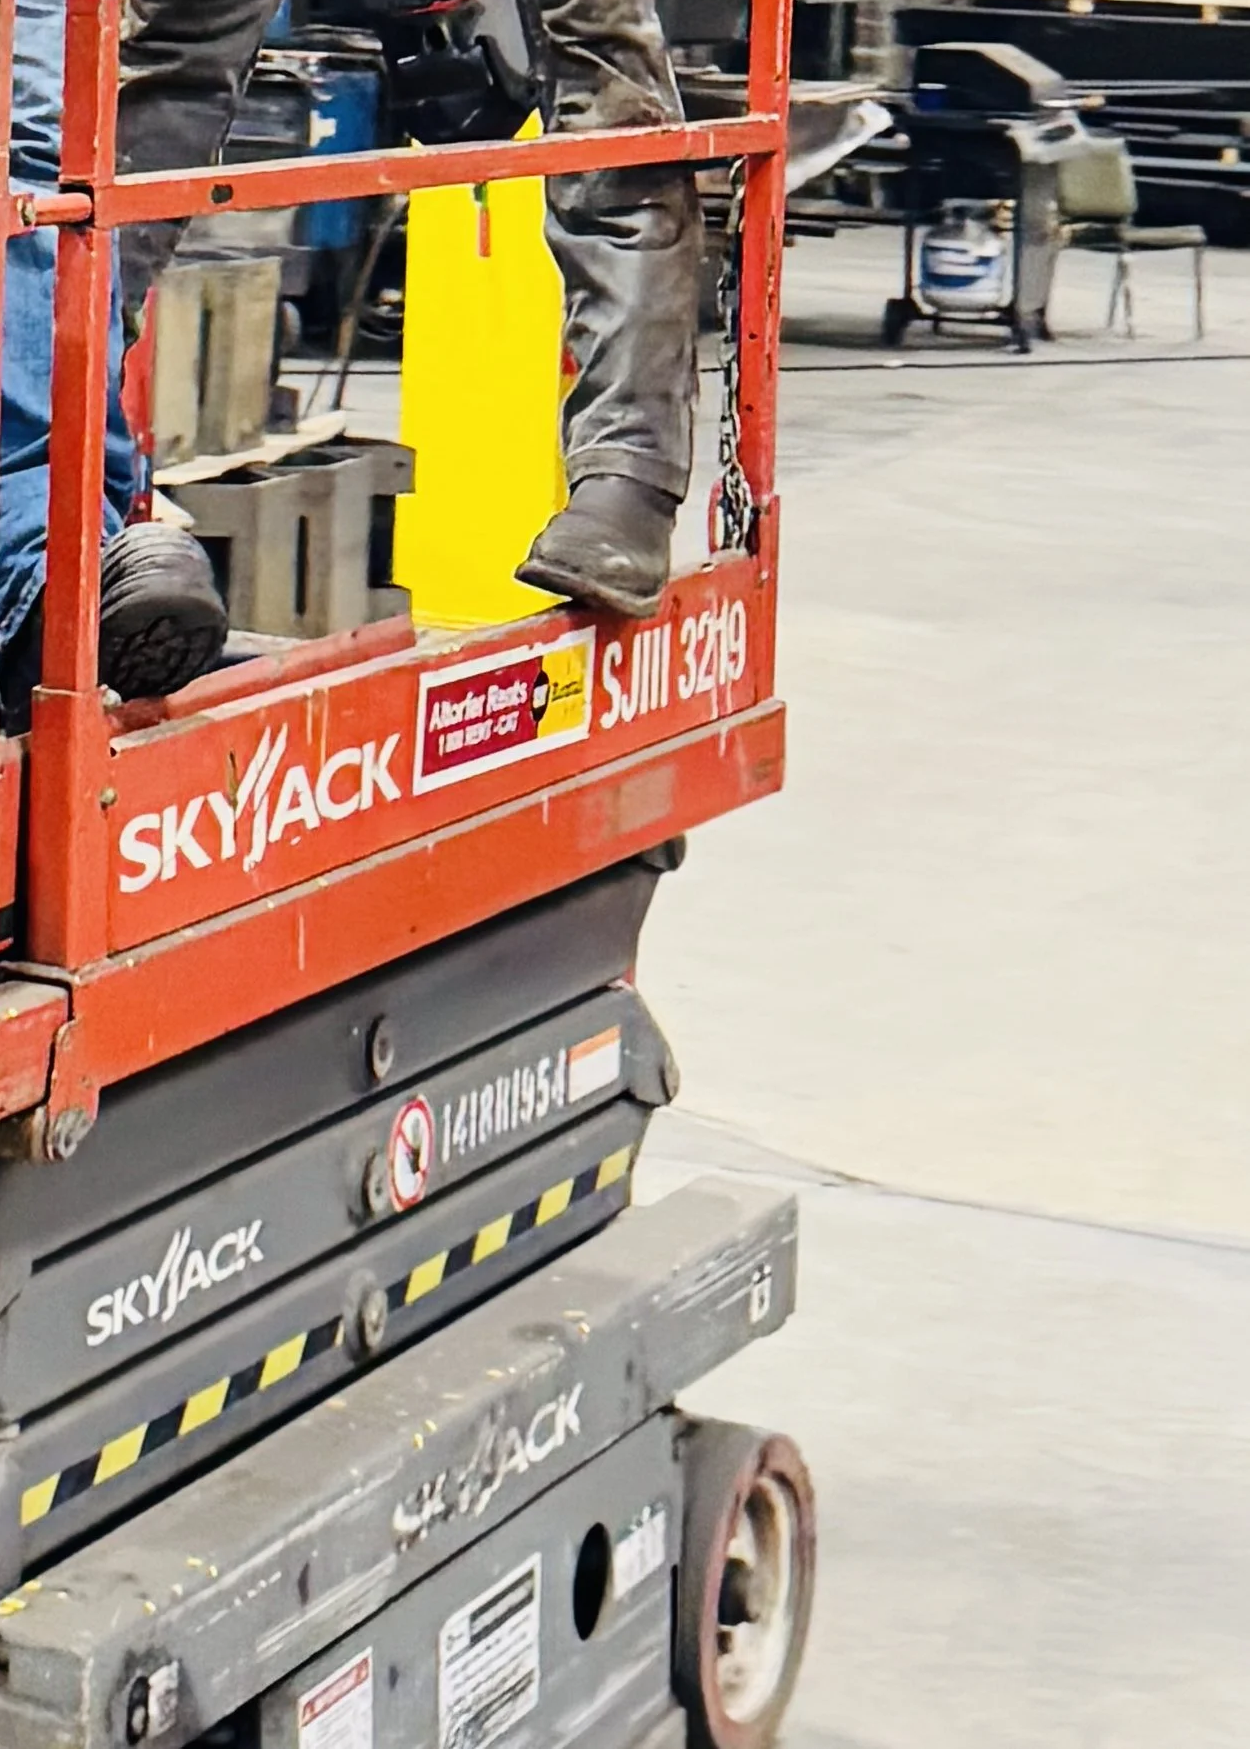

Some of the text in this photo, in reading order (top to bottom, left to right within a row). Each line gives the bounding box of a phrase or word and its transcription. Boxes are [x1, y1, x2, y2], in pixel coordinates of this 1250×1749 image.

[678, 597, 747, 700] 3219
[118, 722, 402, 893] SKYJACK
[85, 1218, 265, 1347] SKYJACK
